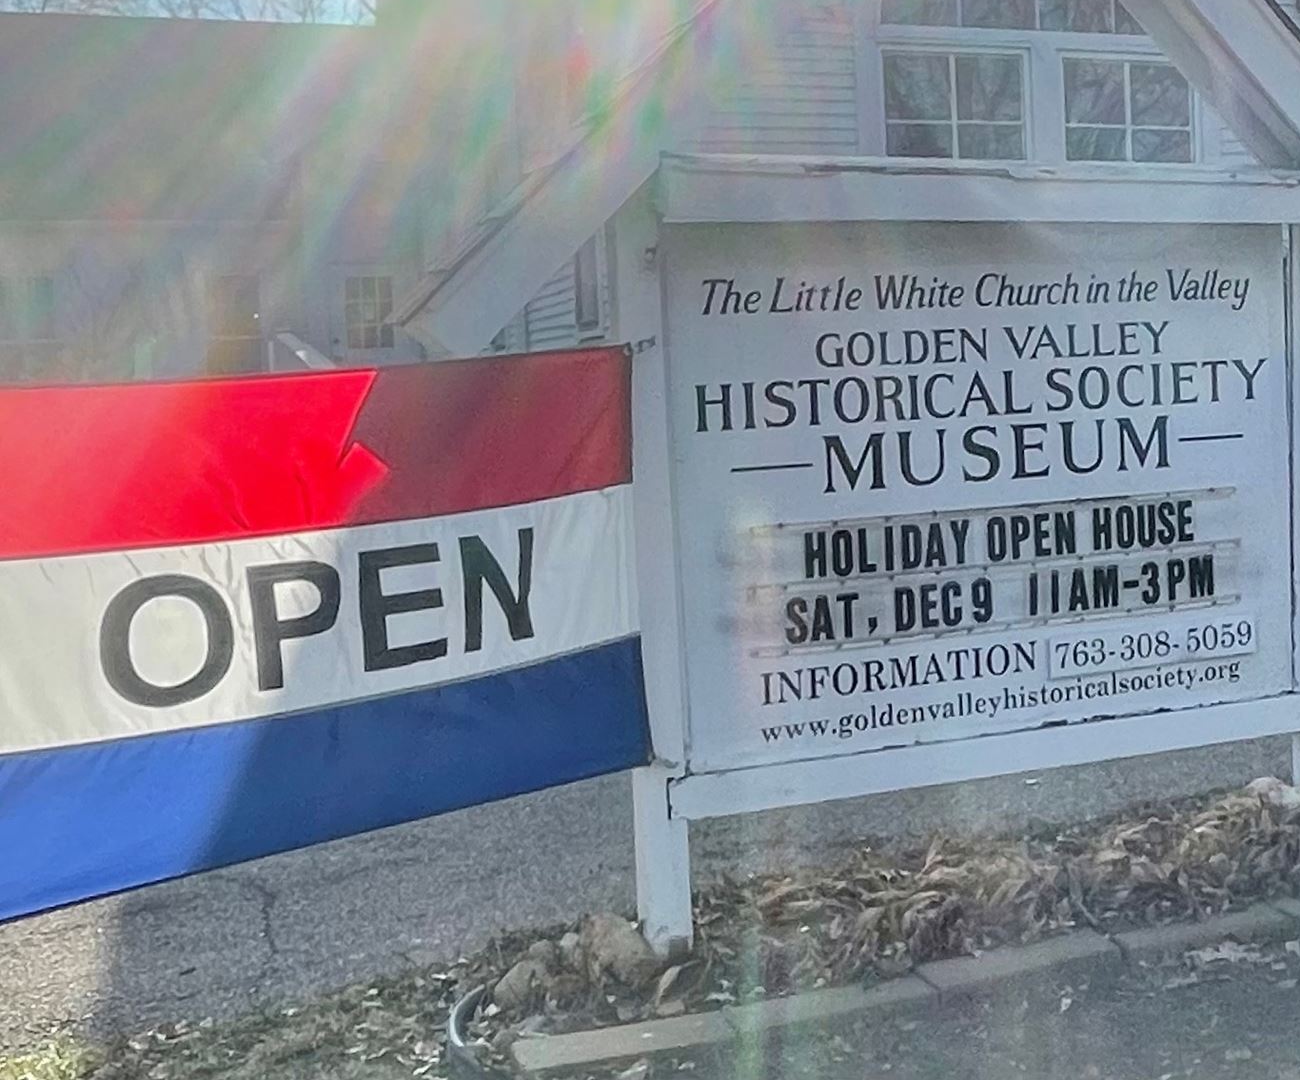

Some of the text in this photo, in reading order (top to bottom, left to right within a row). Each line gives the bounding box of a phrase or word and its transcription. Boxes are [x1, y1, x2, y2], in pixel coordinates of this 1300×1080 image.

[701, 268, 1250, 315] The Little White Church in the Valley
[815, 320, 1169, 367] GOLDEN VALLEY
[695, 358, 1267, 432] HISTORICAL SOCIETY
[822, 415, 1171, 494] MUSEUM
[804, 499, 1195, 579] HOLIDAY OPEN HOUSE
[99, 526, 535, 708] OPEN
[785, 592, 878, 644] SAT,
[1029, 555, 1215, 616] 11AM-3PM
[761, 620, 1252, 706] INFORMATION 763-308-5059
[761, 660, 1241, 743] www.goldenvalleyhistoricalsociety.org
